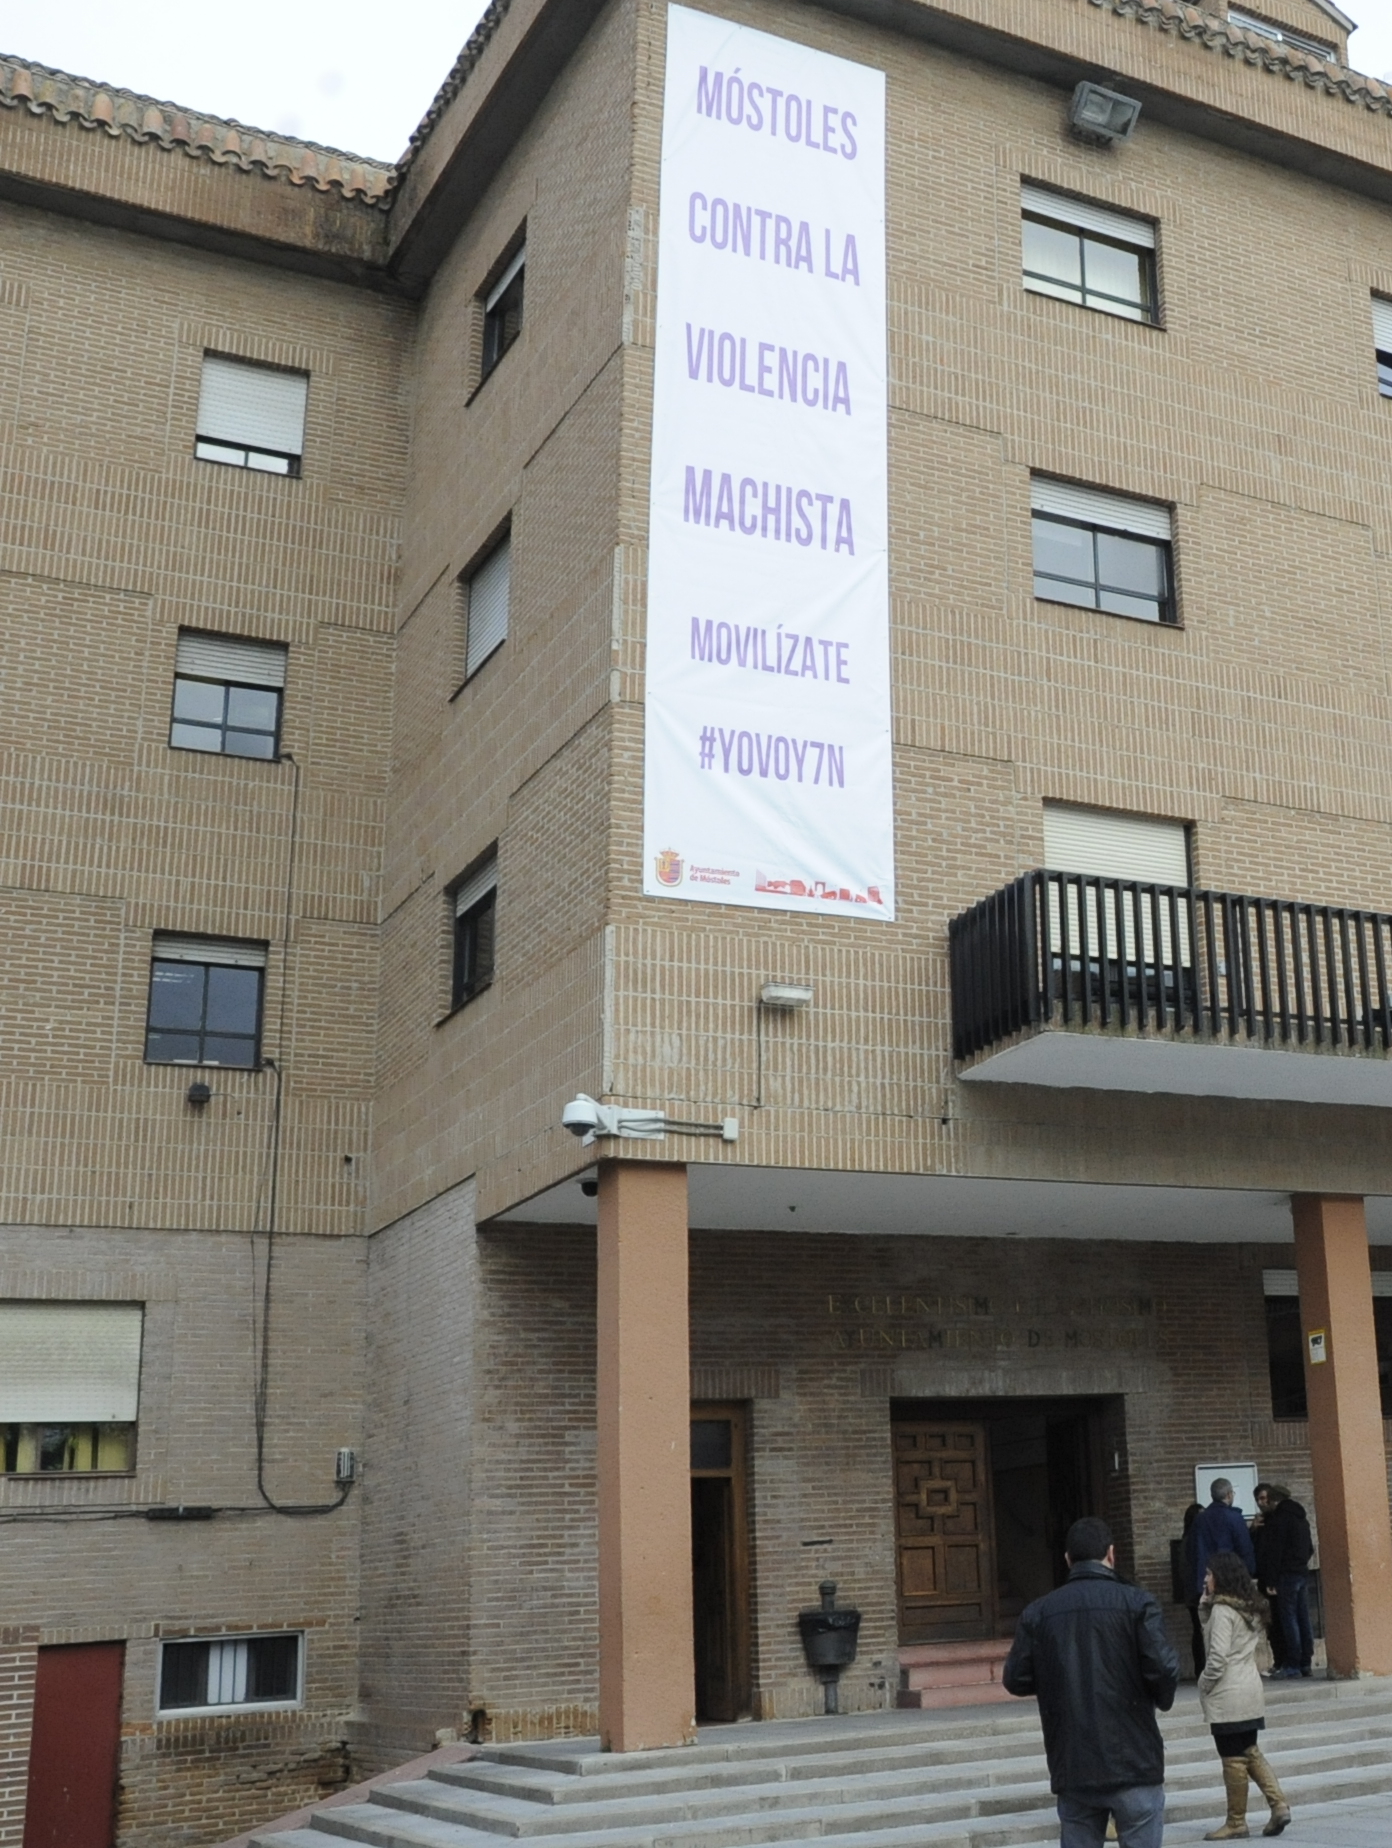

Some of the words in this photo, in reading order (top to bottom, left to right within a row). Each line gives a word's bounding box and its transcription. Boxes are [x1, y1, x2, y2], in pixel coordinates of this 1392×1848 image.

[697, 65, 858, 161] MÓSTOLES
[688, 191, 814, 274] CONTRA
[824, 227, 861, 287] LA
[685, 321, 852, 416] VIOLENCIA
[683, 465, 856, 557] MACHISTA
[690, 616, 851, 685] MOVILÍZATE
[699, 725, 846, 789] #YOVOY7N
[690, 865, 740, 877] Ayuntamiento
[828, 1294, 1004, 1317] ECELENTISIMO
